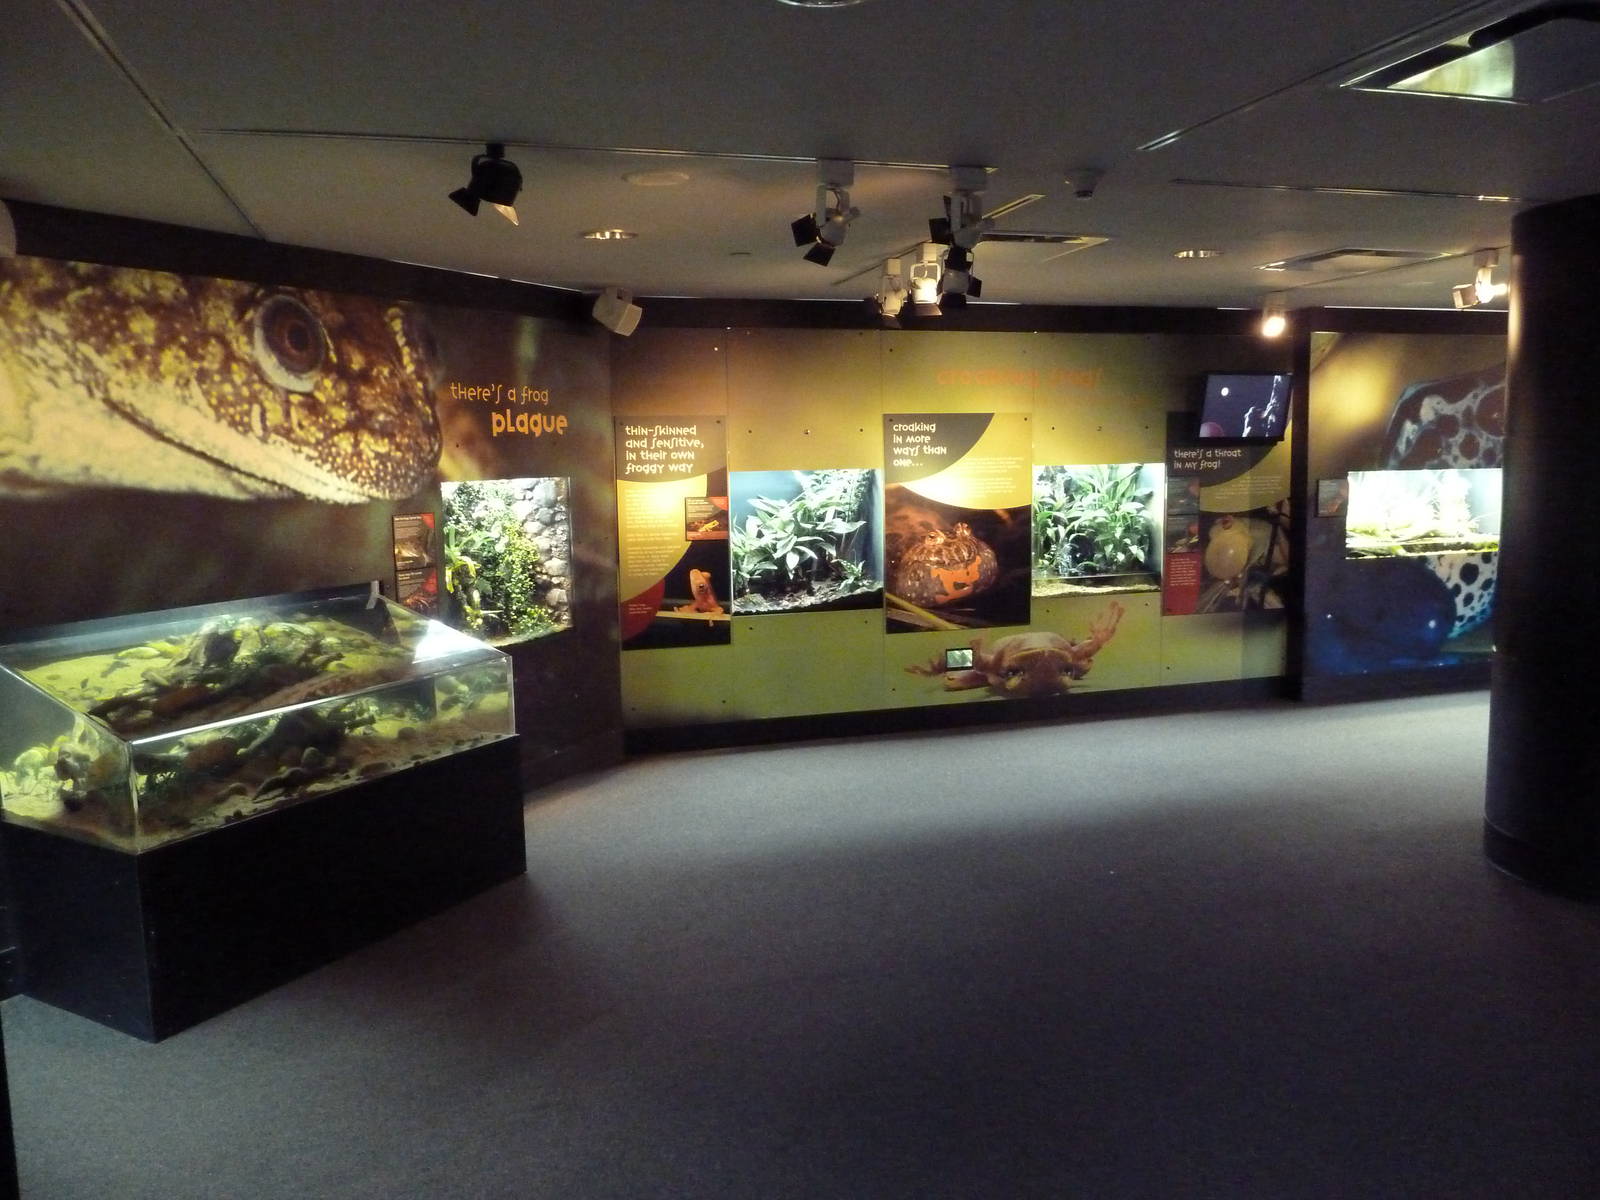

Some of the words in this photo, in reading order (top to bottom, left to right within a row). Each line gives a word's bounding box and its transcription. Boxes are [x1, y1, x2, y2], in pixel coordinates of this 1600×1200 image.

[450, 382, 502, 404] there's
[508, 388, 516, 402] a
[521, 386, 549, 405] frog
[491, 408, 568, 437] plaque
[893, 421, 936, 433] croaking
[625, 425, 697, 437] thin-skinned
[625, 438, 648, 448] and
[650, 437, 705, 449] sensitive,
[893, 434, 903, 444] in
[905, 435, 931, 443] more
[625, 450, 637, 461] in
[640, 450, 668, 460] their
[670, 451, 695, 460] own
[893, 445, 920, 457] ways
[922, 445, 947, 455] than
[1174, 449, 1204, 459] there's
[1205, 450, 1212, 458] a
[1214, 449, 1242, 457] throat
[625, 462, 665, 475] froggy
[668, 463, 694, 473] way
[1173, 460, 1182, 469] in
[1184, 461, 1198, 470] my
